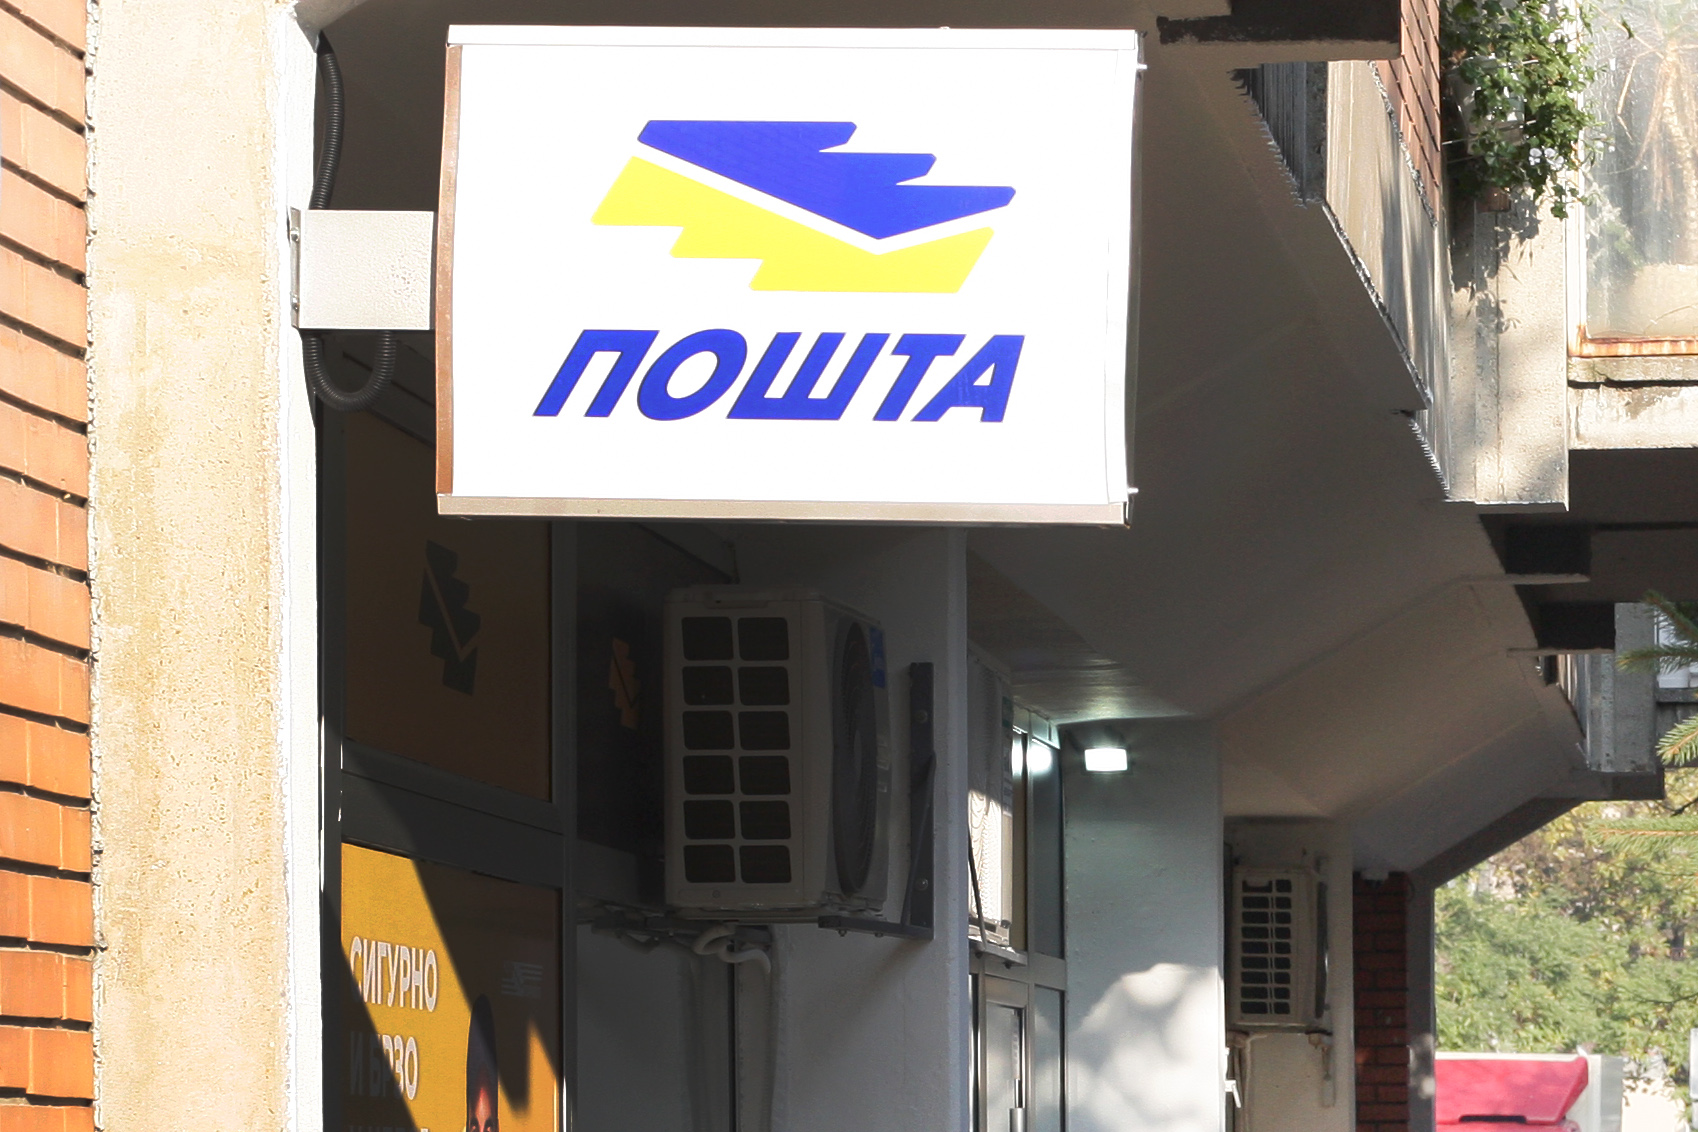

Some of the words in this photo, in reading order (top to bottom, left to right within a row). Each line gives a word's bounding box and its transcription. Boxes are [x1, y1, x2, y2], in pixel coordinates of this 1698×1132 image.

[533, 329, 1024, 423] ПОШТА
[350, 935, 438, 1012] СИГУРНО
[350, 1031, 364, 1097] И
[370, 1034, 419, 1100] БРЗО
